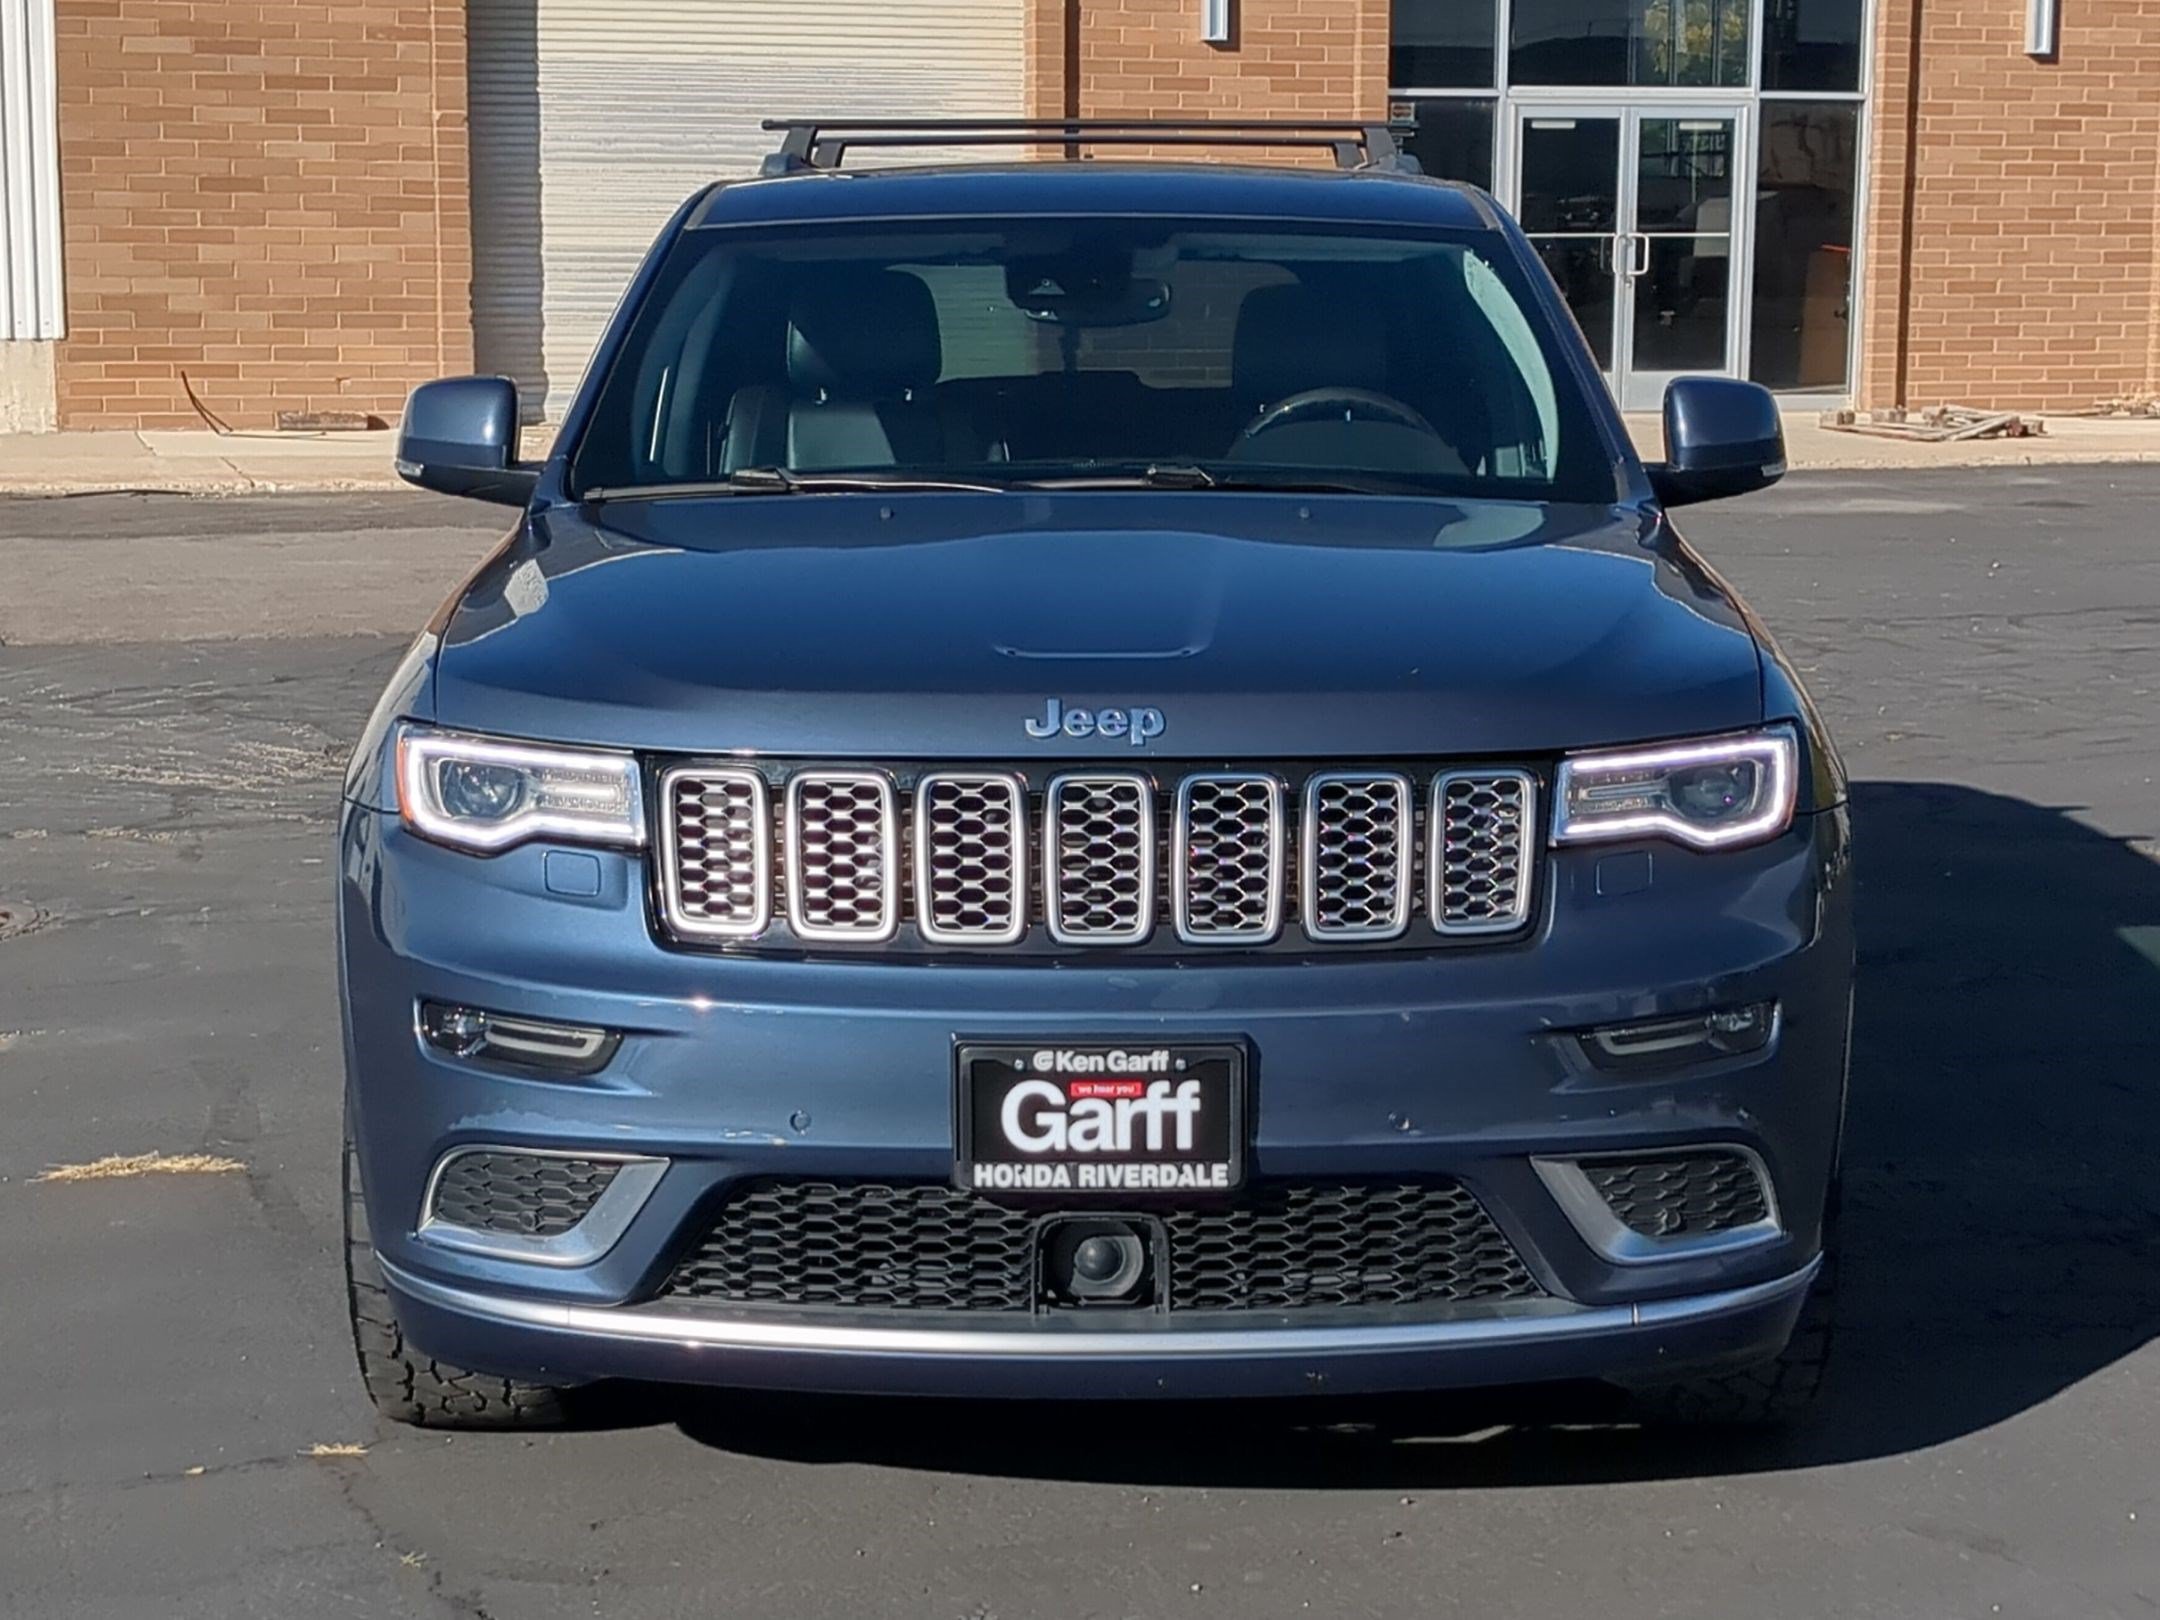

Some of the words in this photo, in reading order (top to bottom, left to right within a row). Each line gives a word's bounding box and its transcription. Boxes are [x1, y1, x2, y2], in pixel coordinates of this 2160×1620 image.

[1025, 699, 1165, 745] Jeep
[1056, 1050, 1105, 1072] Ken
[1107, 1050, 1169, 1072] Garff
[1078, 1085, 1092, 1094] we
[1093, 1083, 1115, 1094] hear
[1116, 1085, 1135, 1096] you
[1001, 1080, 1200, 1152] Garff
[973, 1164, 1071, 1188] HONDA
[1078, 1163, 1228, 1187] RIVERDALE
